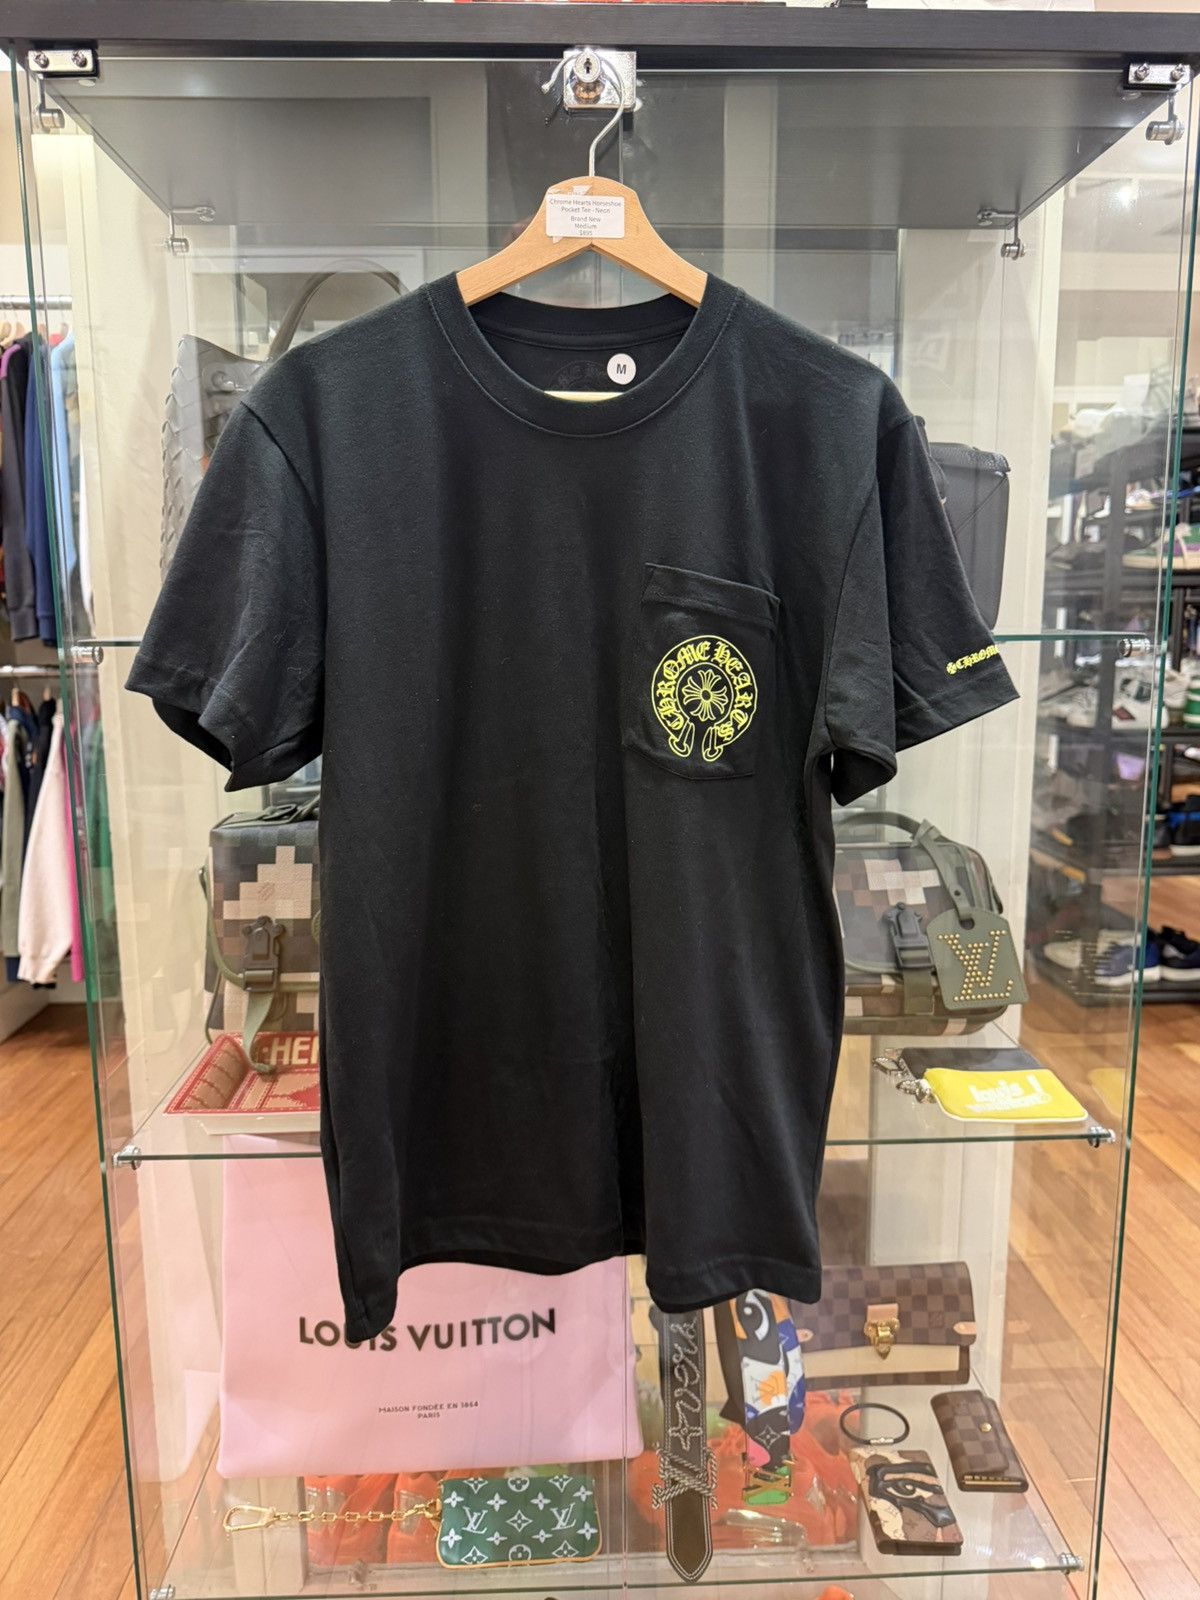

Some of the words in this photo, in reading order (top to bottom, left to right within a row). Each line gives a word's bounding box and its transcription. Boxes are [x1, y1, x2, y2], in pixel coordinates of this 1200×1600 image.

[616, 363, 627, 375] M
[299, 1317, 397, 1351] LOS
[406, 1308, 556, 1351] VUITTON
